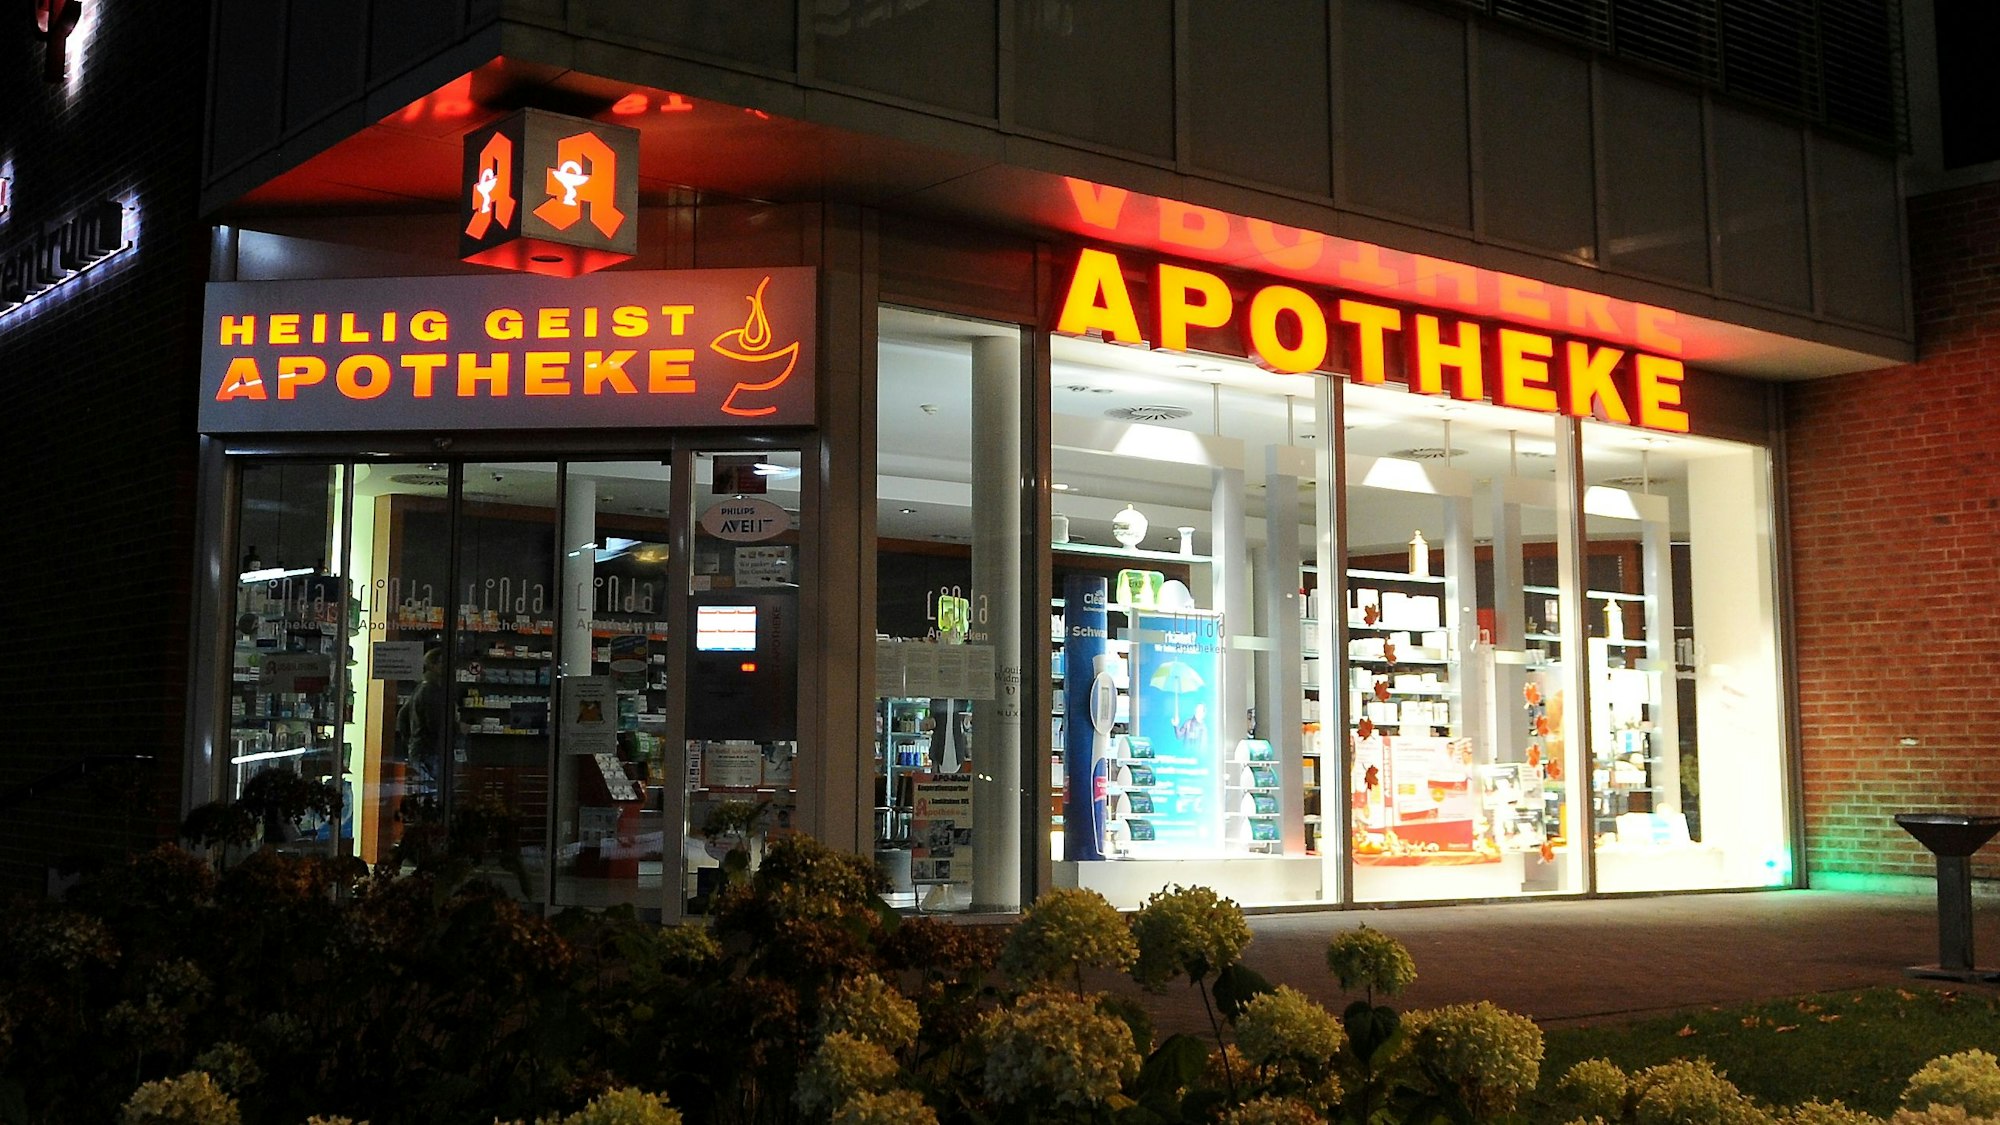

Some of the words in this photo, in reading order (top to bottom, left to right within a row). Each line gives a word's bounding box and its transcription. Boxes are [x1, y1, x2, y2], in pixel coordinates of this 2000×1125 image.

[219, 309, 449, 345] HEILIG
[484, 304, 696, 341] GEIST
[1054, 247, 1690, 433] APOTHEKE
[215, 348, 697, 400] APOTHEKE
[721, 507, 755, 515] PHILIPS
